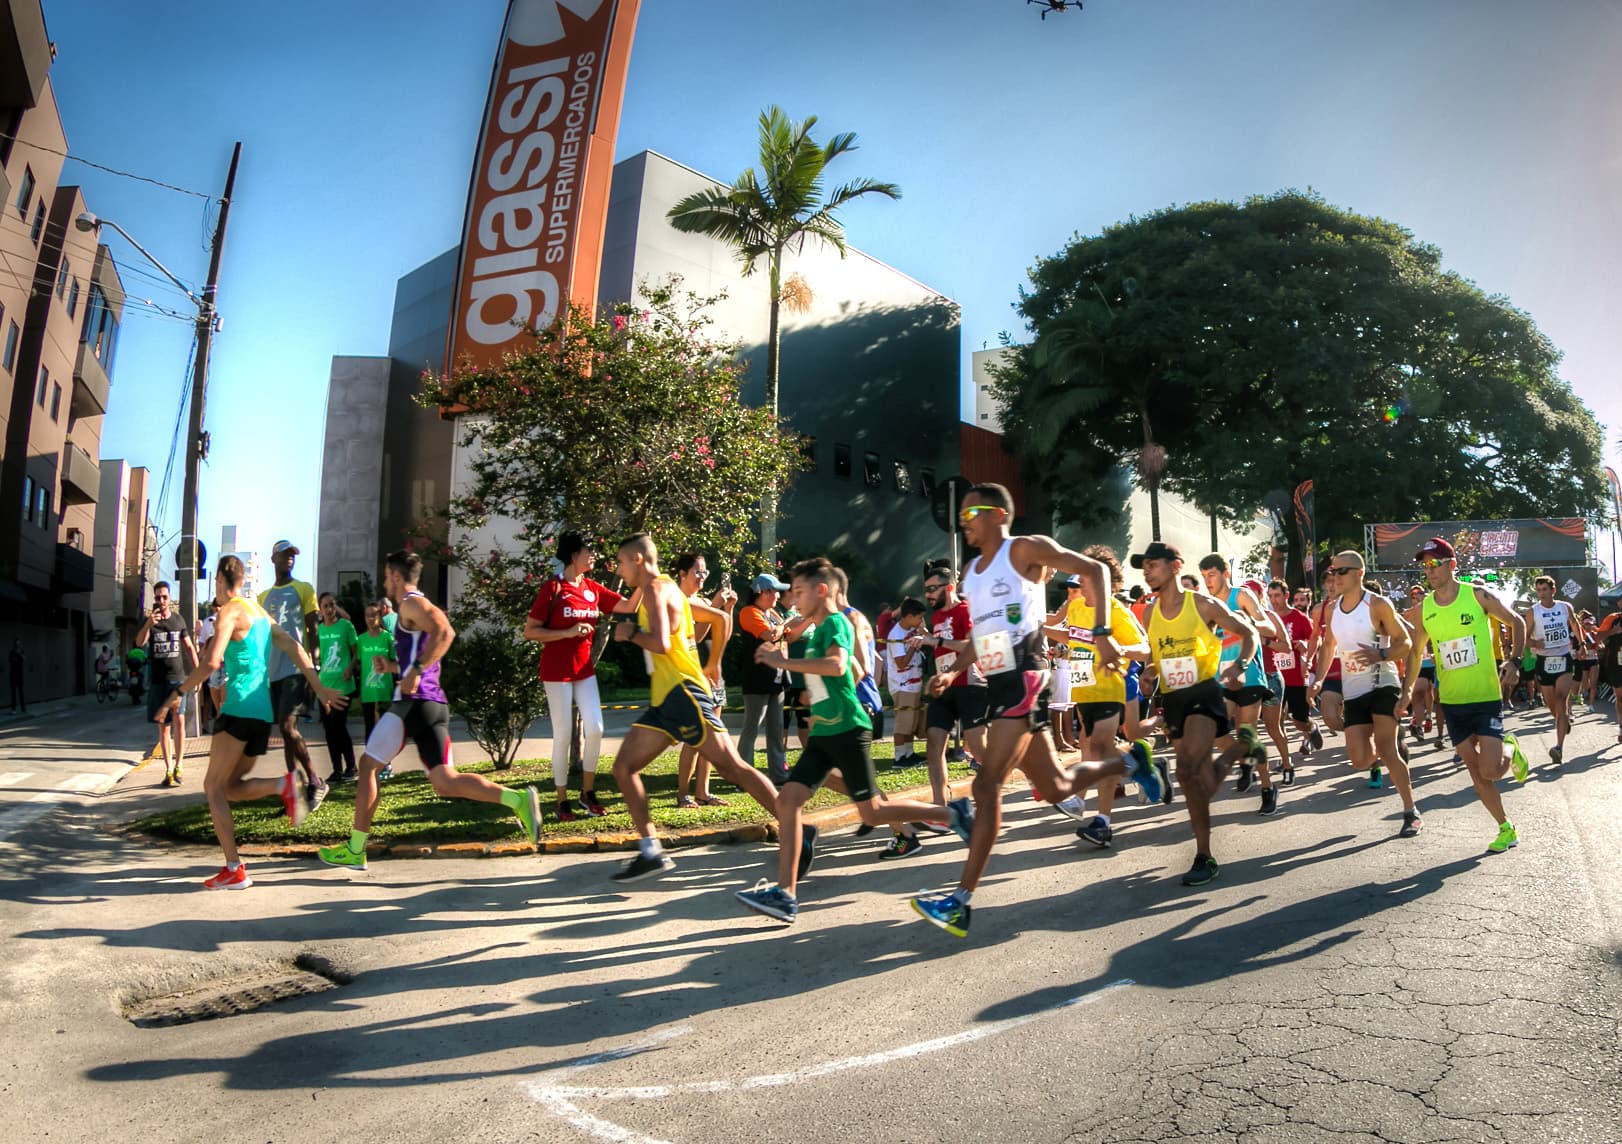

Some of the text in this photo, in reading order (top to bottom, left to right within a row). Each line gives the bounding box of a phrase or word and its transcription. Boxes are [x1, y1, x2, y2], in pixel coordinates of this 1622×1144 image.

[545, 51, 596, 264] SUPERMERCADOS
[1542, 610, 1562, 619] EU
[1446, 649, 1469, 666] 107
[1547, 663, 1562, 671] 207
[1168, 670, 1195, 687] 520
